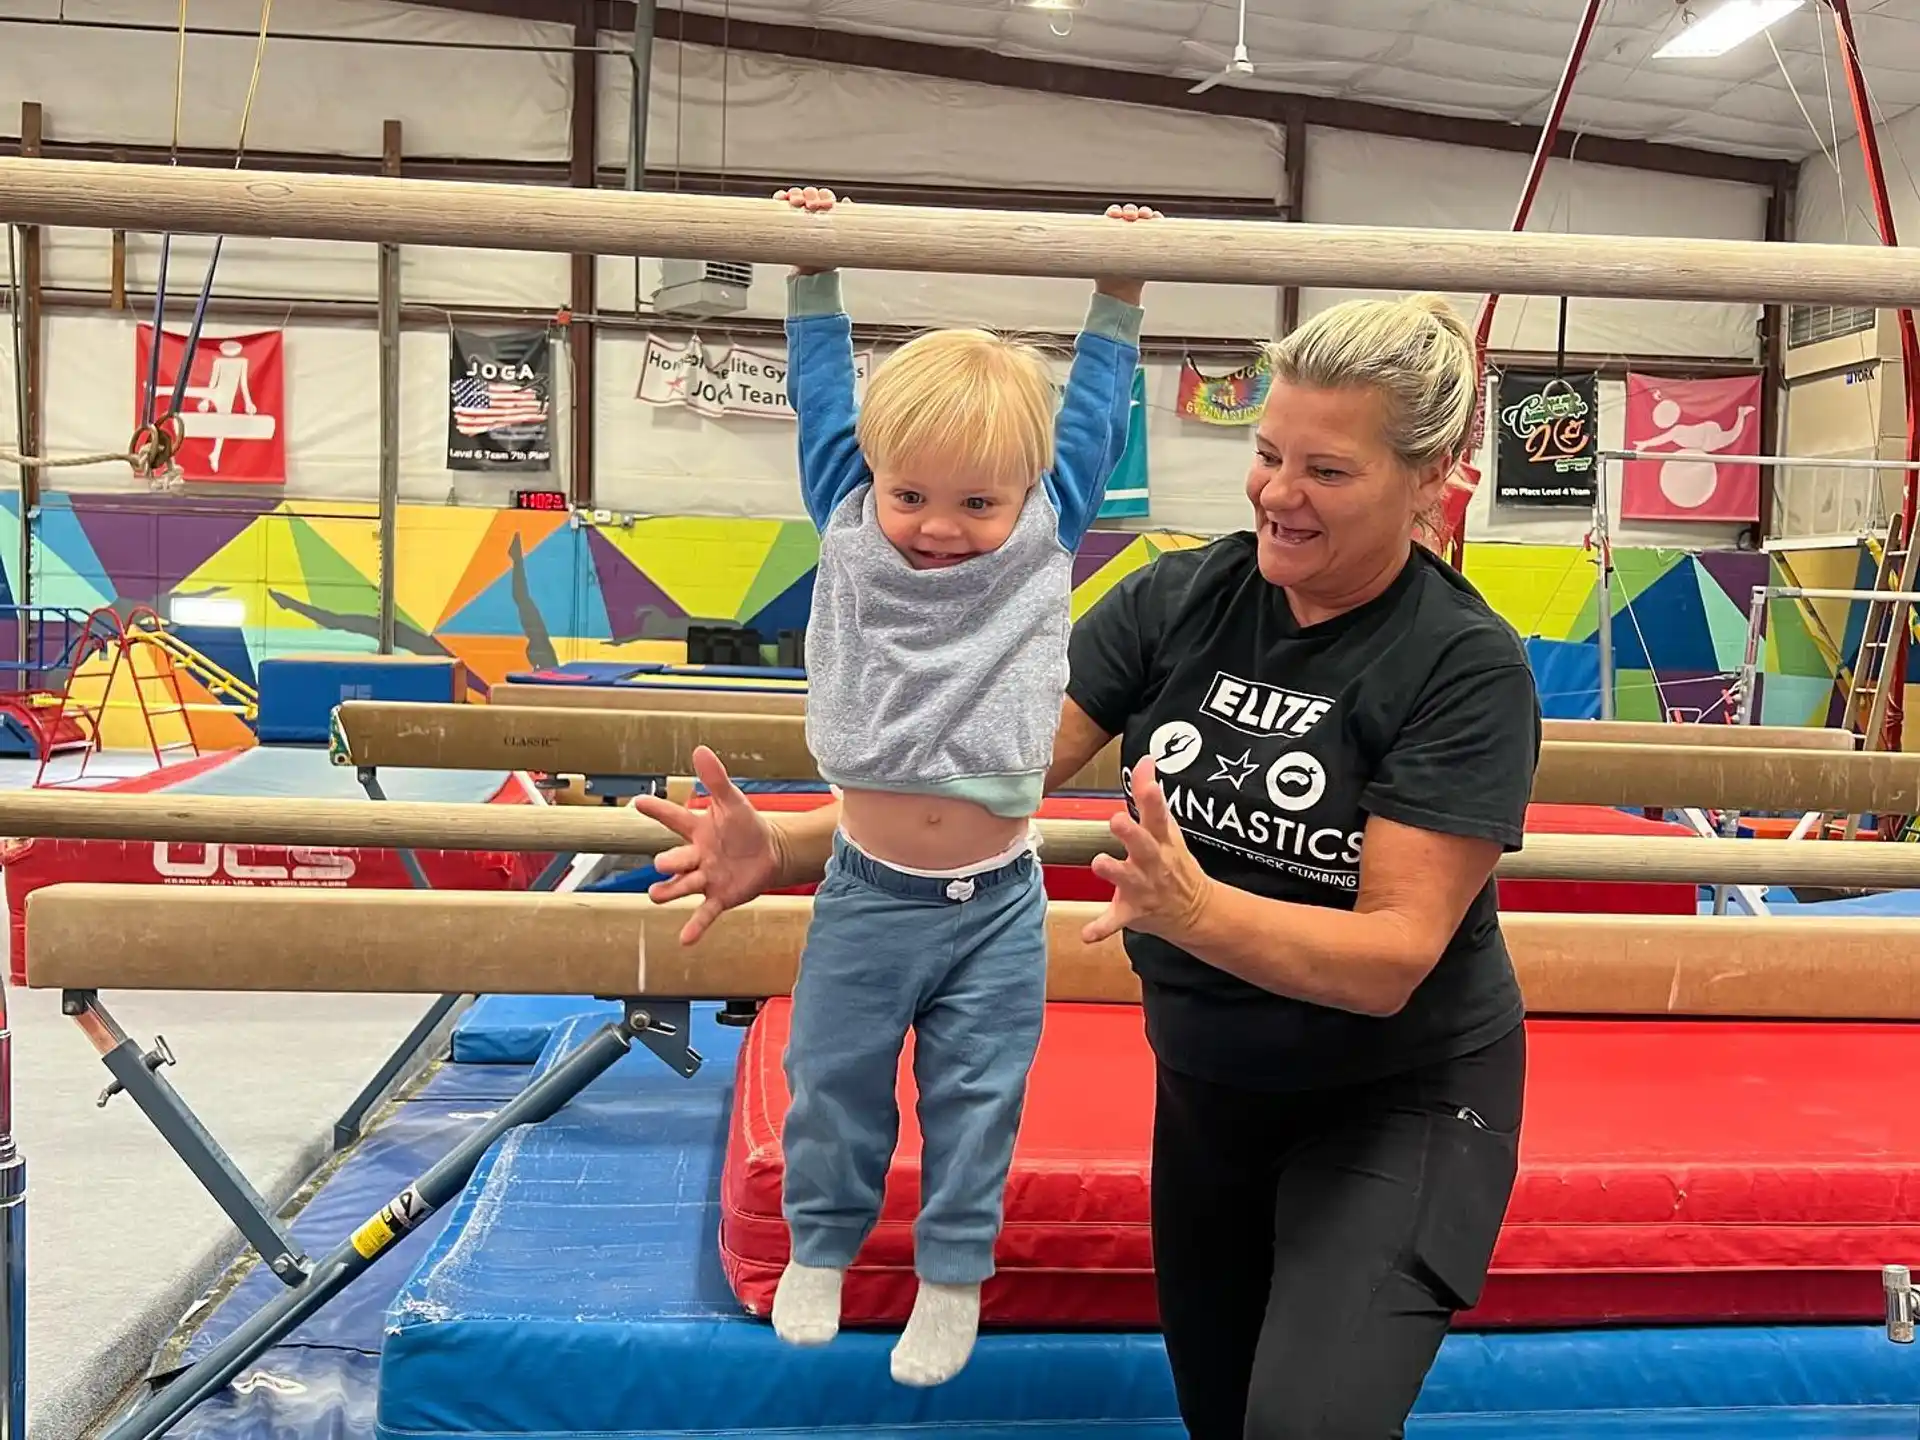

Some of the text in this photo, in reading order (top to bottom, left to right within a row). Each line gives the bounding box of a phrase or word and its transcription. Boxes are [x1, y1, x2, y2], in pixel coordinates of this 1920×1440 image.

[466, 362, 535, 380] JOGA
[484, 450, 509, 460] Team
[510, 450, 527, 460] 7th
[1501, 487, 1591, 496] 10th Place Level 4 Team
[1209, 678, 1333, 735] ELITE
[1121, 766, 1363, 865] GMNASTICS
[1247, 853, 1357, 887] ROCK CLIMBING
